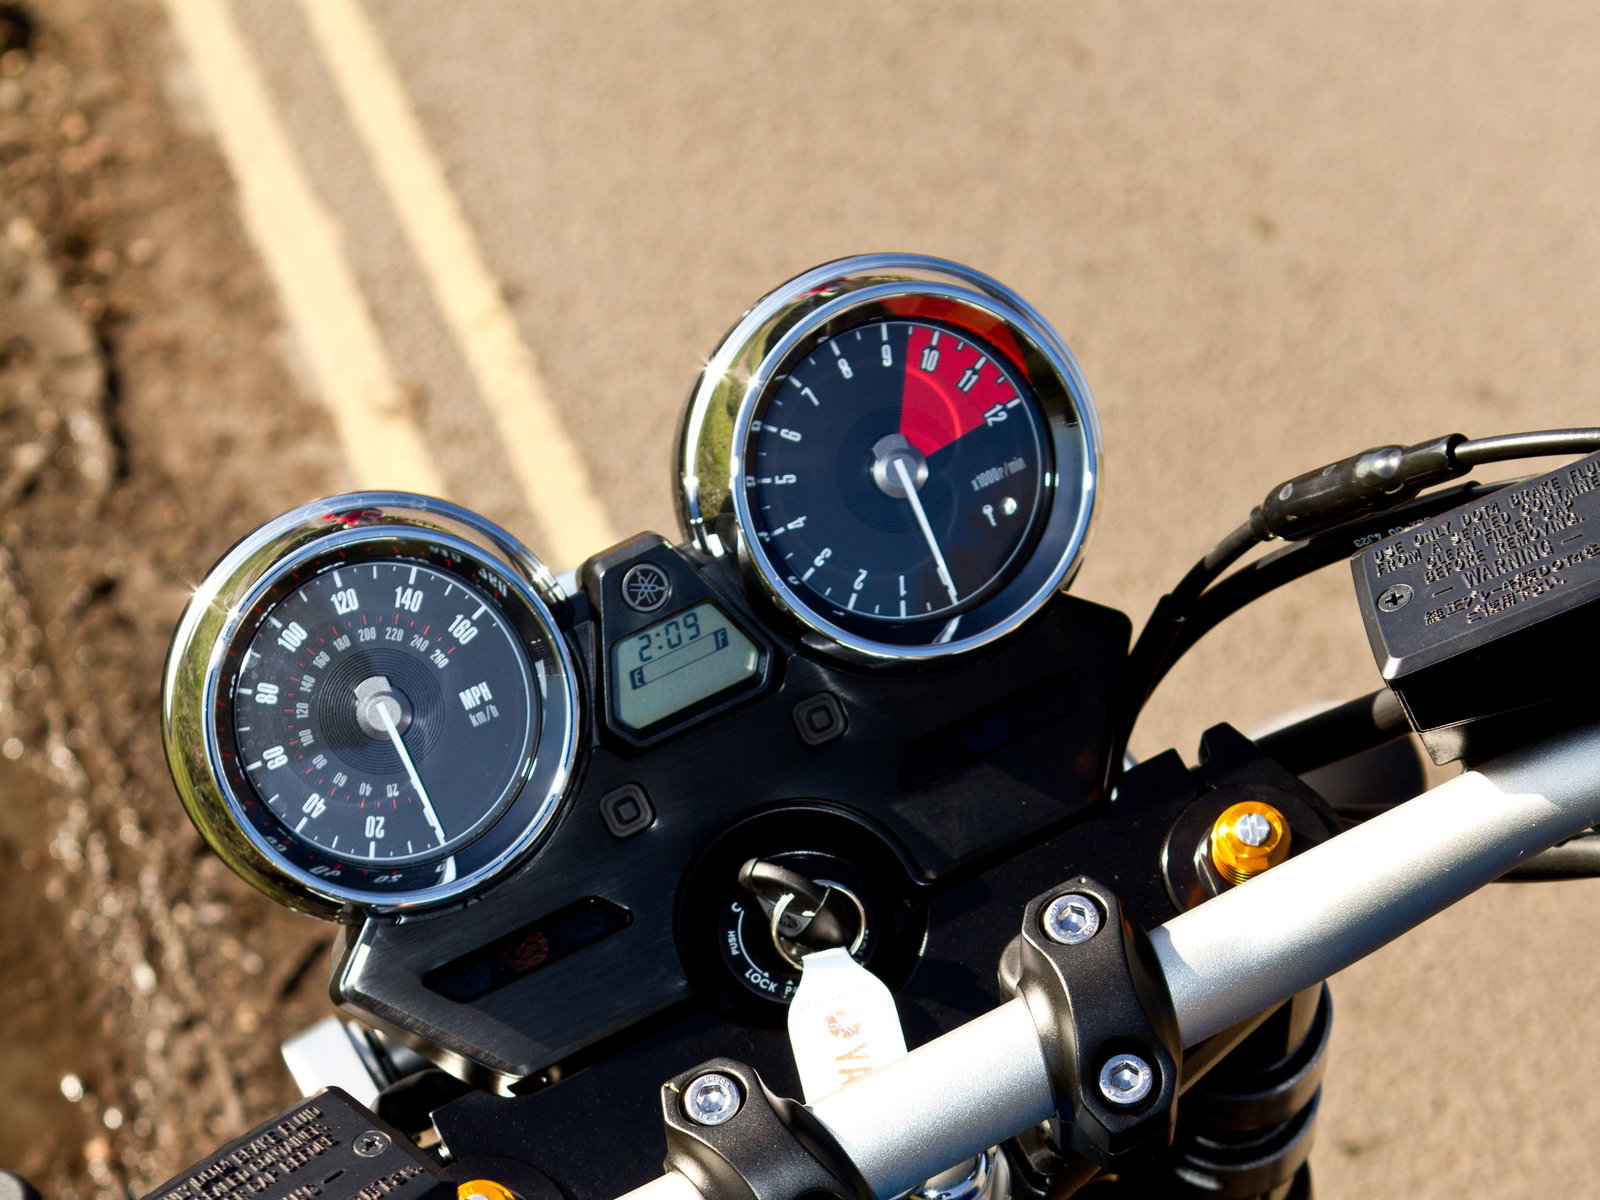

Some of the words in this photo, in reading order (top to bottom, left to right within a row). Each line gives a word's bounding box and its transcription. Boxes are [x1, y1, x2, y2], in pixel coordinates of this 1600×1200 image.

[881, 345, 893, 367] 9
[920, 348, 941, 373] 10
[837, 358, 854, 380] 8
[956, 368, 981, 394] 11
[801, 386, 820, 406] 7
[984, 403, 1008, 427] 12
[780, 428, 802, 443] 6
[775, 474, 797, 486] 5
[787, 515, 807, 530] 4
[1374, 542, 1403, 563] USE
[1413, 522, 1452, 546] ONLY
[1461, 503, 1500, 527] DOT4
[1510, 478, 1561, 508] BRAKE
[1377, 549, 1422, 577] FROM
[1431, 542, 1442, 554] A
[1451, 512, 1511, 544] SEALED
[1426, 542, 1476, 569] CLEAN
[1484, 516, 1535, 546] FILLER
[1543, 500, 1574, 521] CAP
[814, 548, 832, 567] 3
[1424, 550, 1486, 584] BEFORE
[1462, 540, 1554, 588] WARNING
[854, 568, 868, 590] 2
[899, 575, 907, 596] 1
[330, 588, 359, 615] 120
[394, 586, 423, 613] 140
[277, 621, 308, 653] 100
[358, 627, 376, 642] 200
[385, 627, 404, 642] 220
[447, 613, 480, 645] 160
[638, 612, 700, 662] 2:09
[333, 634, 352, 652] 180
[410, 633, 428, 653] 240
[312, 650, 331, 669] 160
[430, 648, 449, 669] 260
[255, 682, 279, 705] 80
[299, 674, 315, 693] 140
[458, 681, 492, 711] MPH
[296, 702, 309, 719] 120
[468, 705, 499, 728] km/h
[299, 728, 314, 747] 100
[262, 744, 288, 772] 60
[312, 754, 327, 770] 80
[333, 772, 347, 787] 60
[358, 782, 372, 796] 40
[387, 782, 399, 797] 20
[302, 792, 327, 820] 40
[365, 815, 385, 838] 20
[727, 930, 740, 956] PUSH
[745, 968, 778, 993] LOCK
